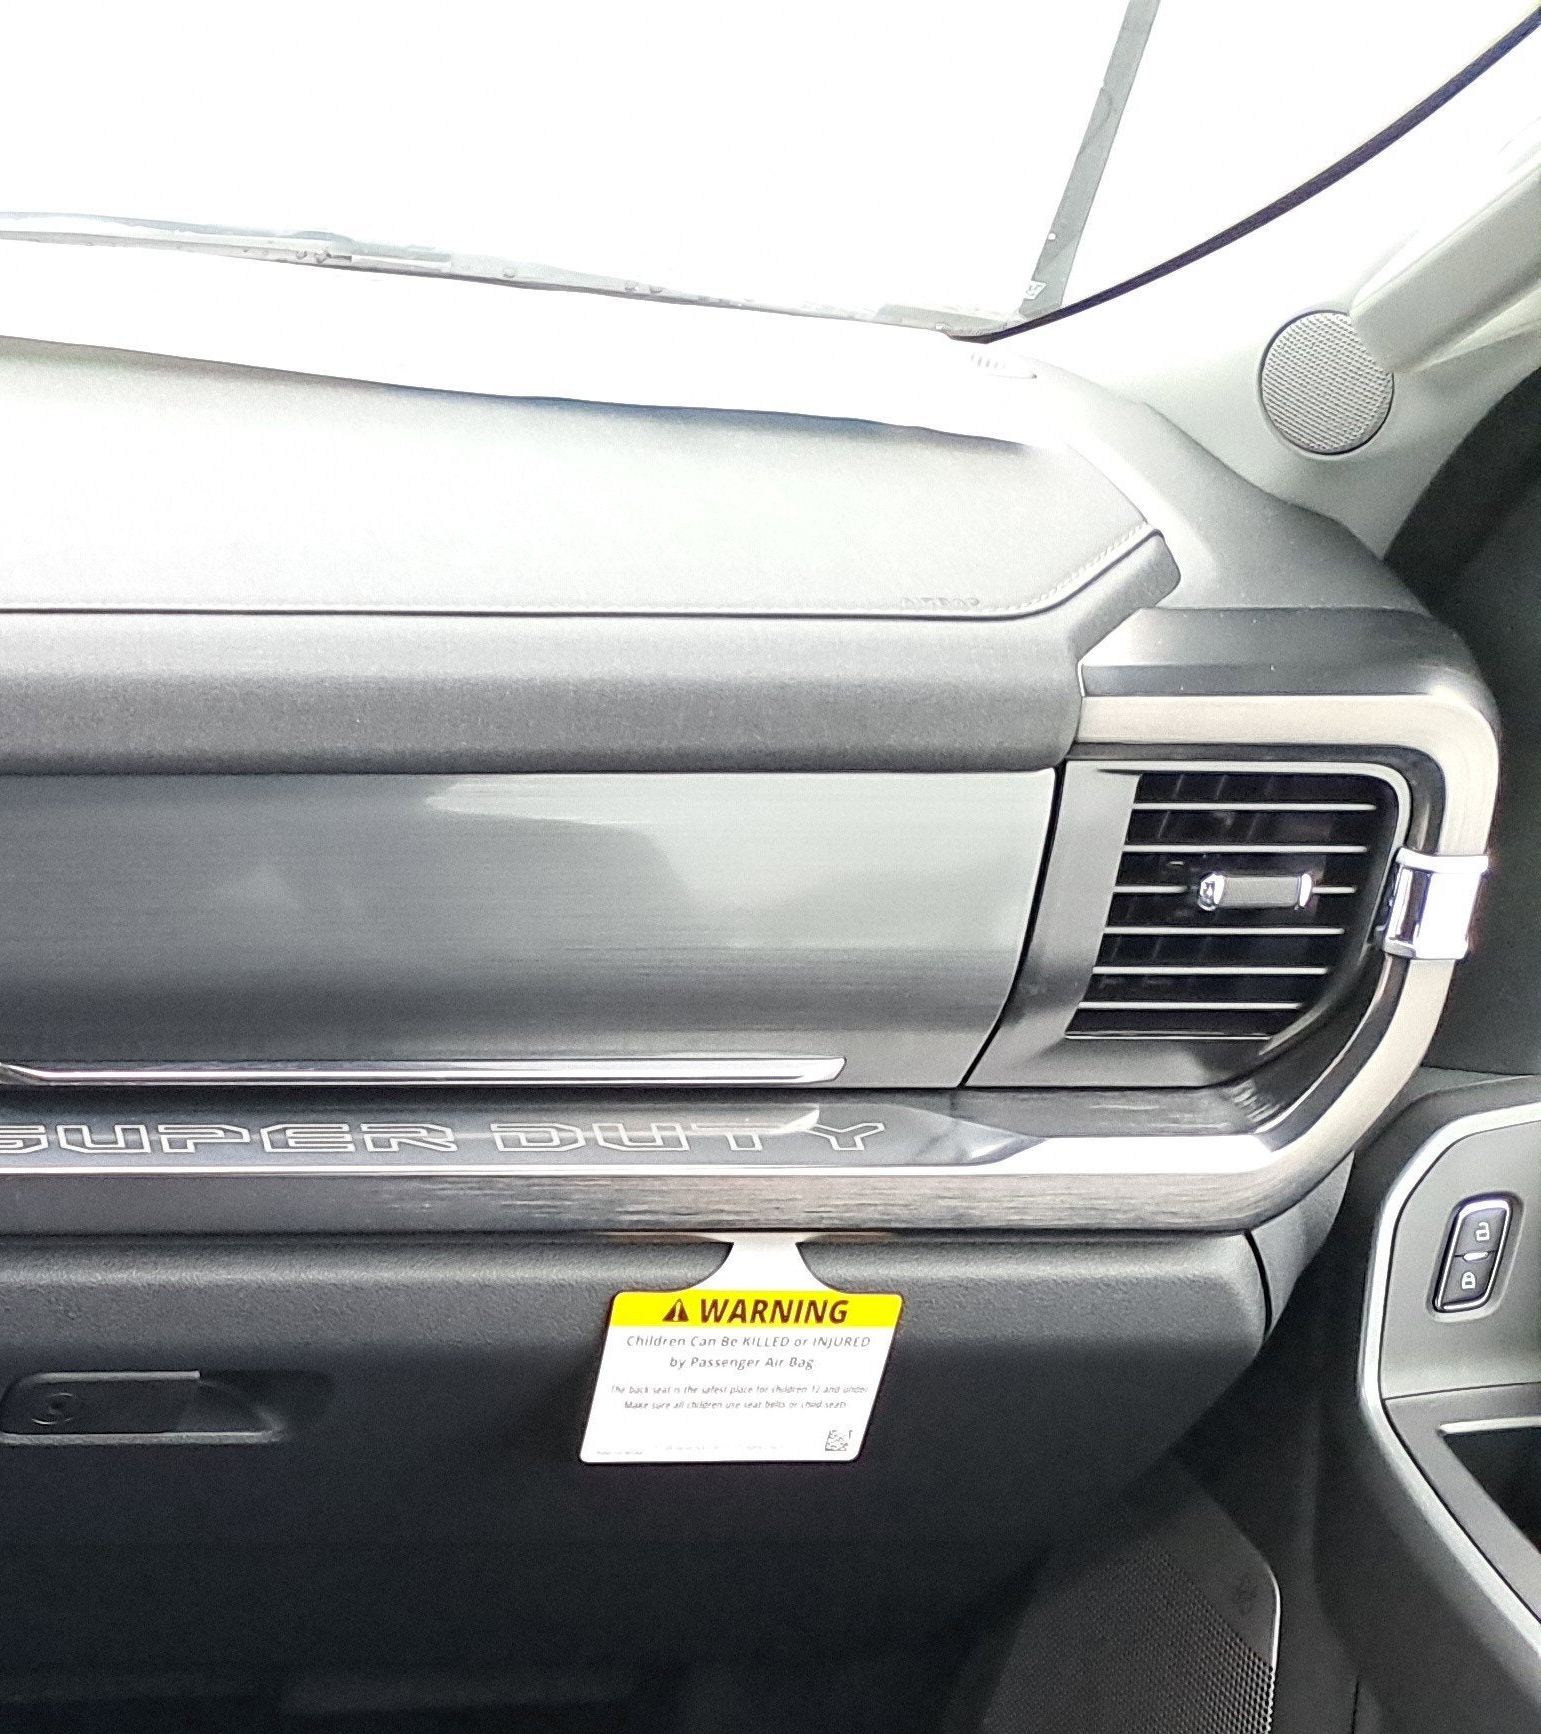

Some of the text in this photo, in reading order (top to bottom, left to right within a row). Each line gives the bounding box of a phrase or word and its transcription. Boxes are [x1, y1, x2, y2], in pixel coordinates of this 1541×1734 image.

[490, 1121, 885, 1153] DUTY
[700, 1298, 850, 1324] WARNING
[626, 1335, 871, 1349] Children Can Be KILLED or INJURED
[670, 1356, 686, 1370] by
[690, 1356, 760, 1371] Passenger
[765, 1357, 784, 1368] Air
